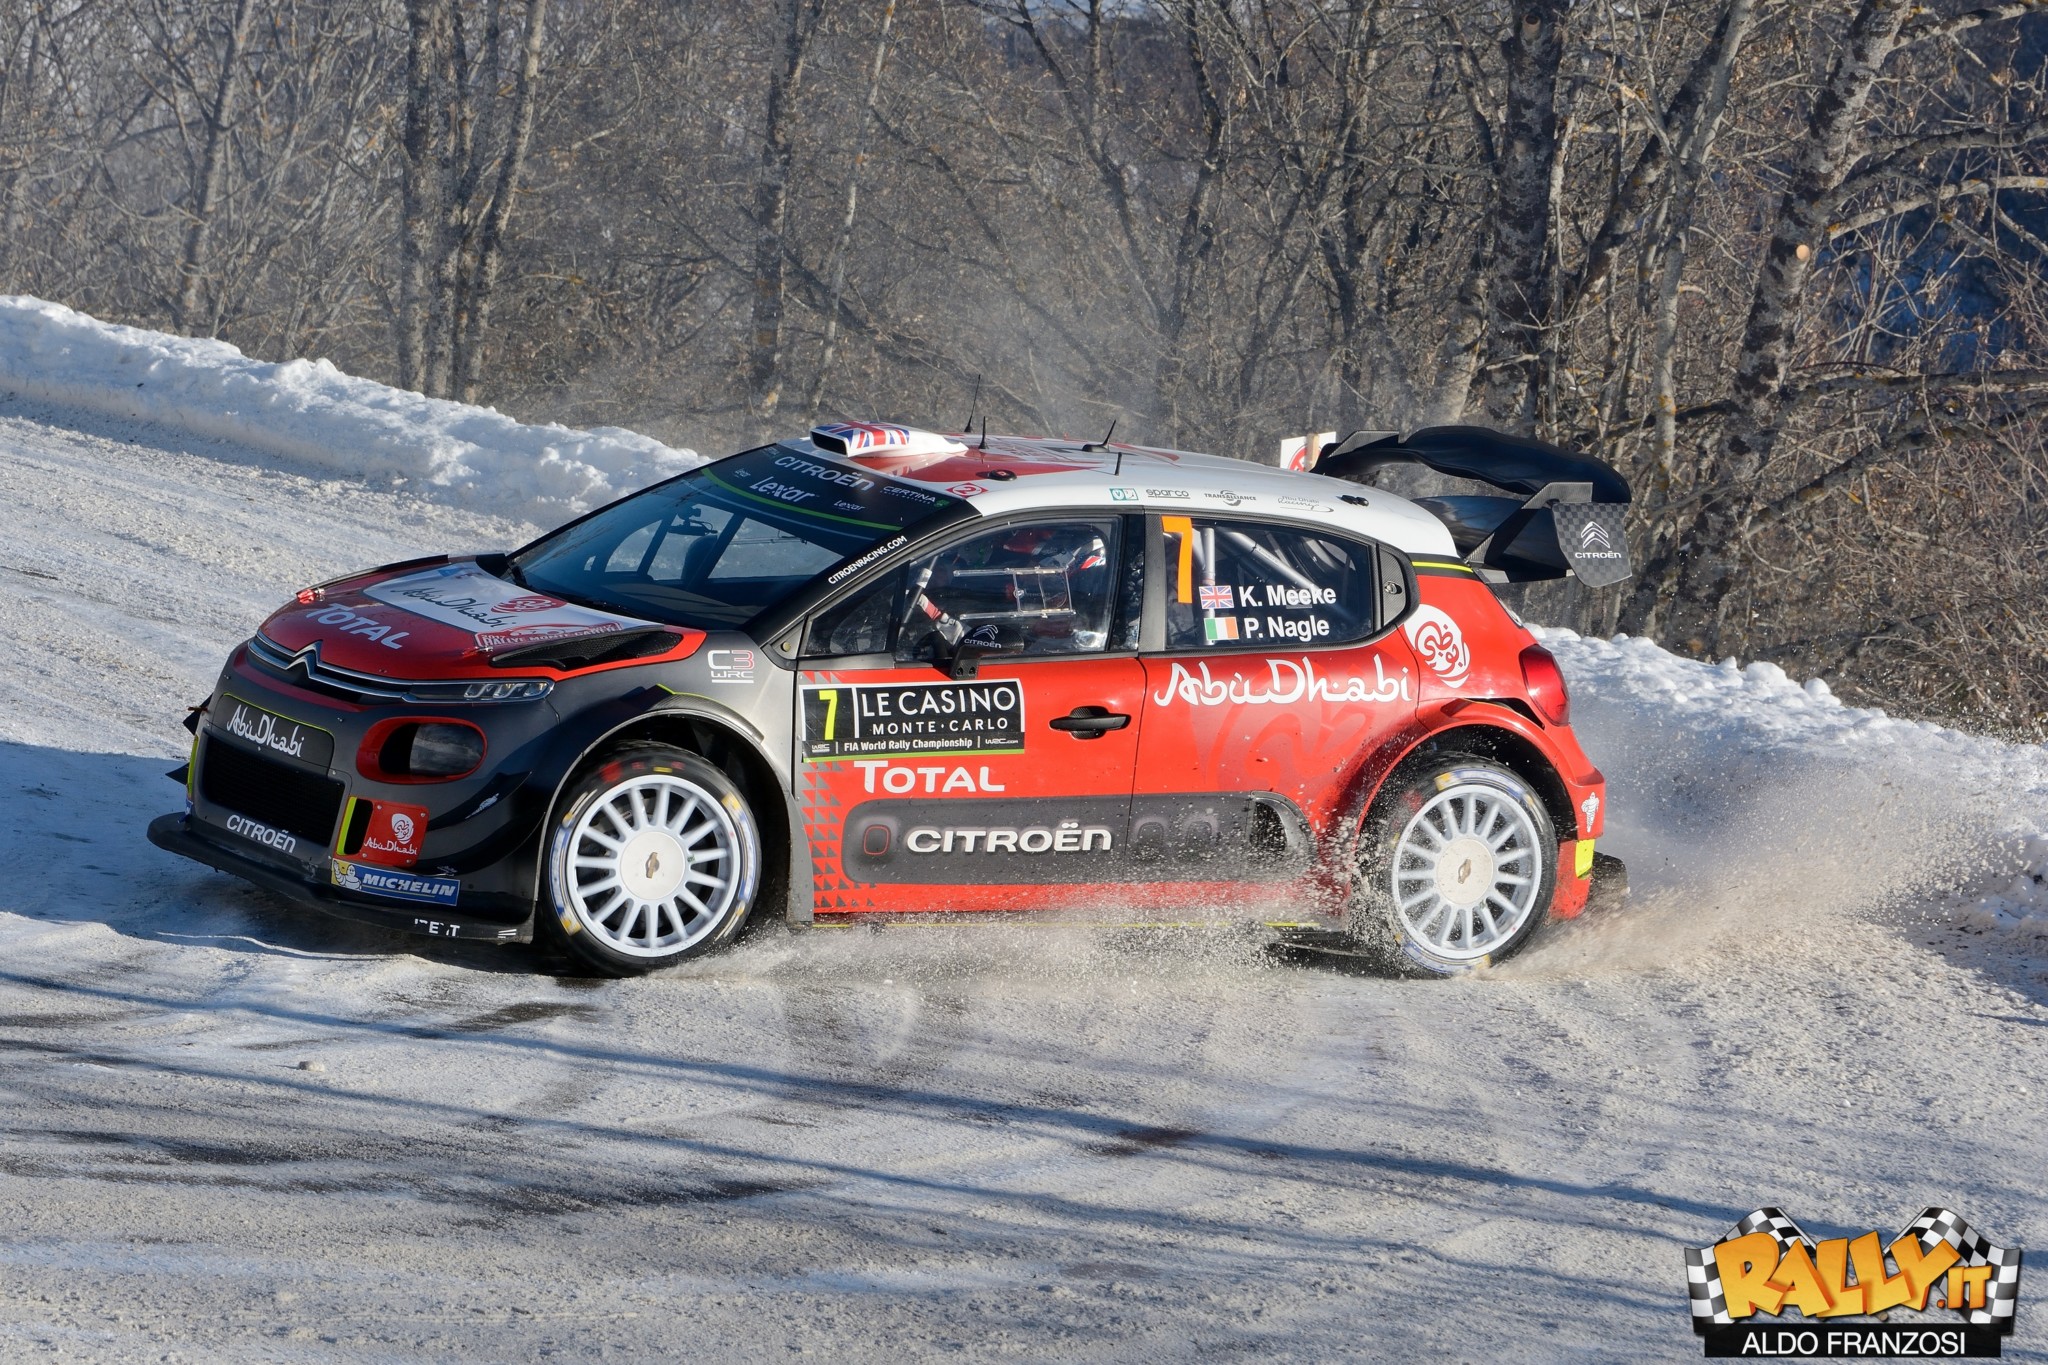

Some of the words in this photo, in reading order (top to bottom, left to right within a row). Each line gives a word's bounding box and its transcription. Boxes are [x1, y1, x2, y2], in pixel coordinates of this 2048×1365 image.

[750, 476, 815, 502] Lexar
[883, 485, 936, 503] CERTINA
[1146, 489, 1189, 498] sparco
[1204, 493, 1257, 501] TRANSALLIANCE
[828, 535, 907, 585] CITROENRACING.COM
[1161, 515, 1192, 603] 7
[1239, 586, 1263, 607] K.
[1266, 584, 1337, 606] Meeke
[306, 603, 411, 650] TOTAL
[1243, 617, 1264, 639] P.
[1267, 615, 1330, 642] Nagle
[707, 650, 754, 670] C3
[819, 690, 838, 740] 7
[861, 693, 891, 717] LE
[898, 687, 1016, 716] CASINO
[844, 742, 859, 752] FIA
[861, 739, 887, 751] World
[889, 737, 911, 751] Rally
[912, 735, 974, 750] Championship
[853, 760, 1005, 794] TOTAL
[363, 873, 456, 896] MICHELIN
